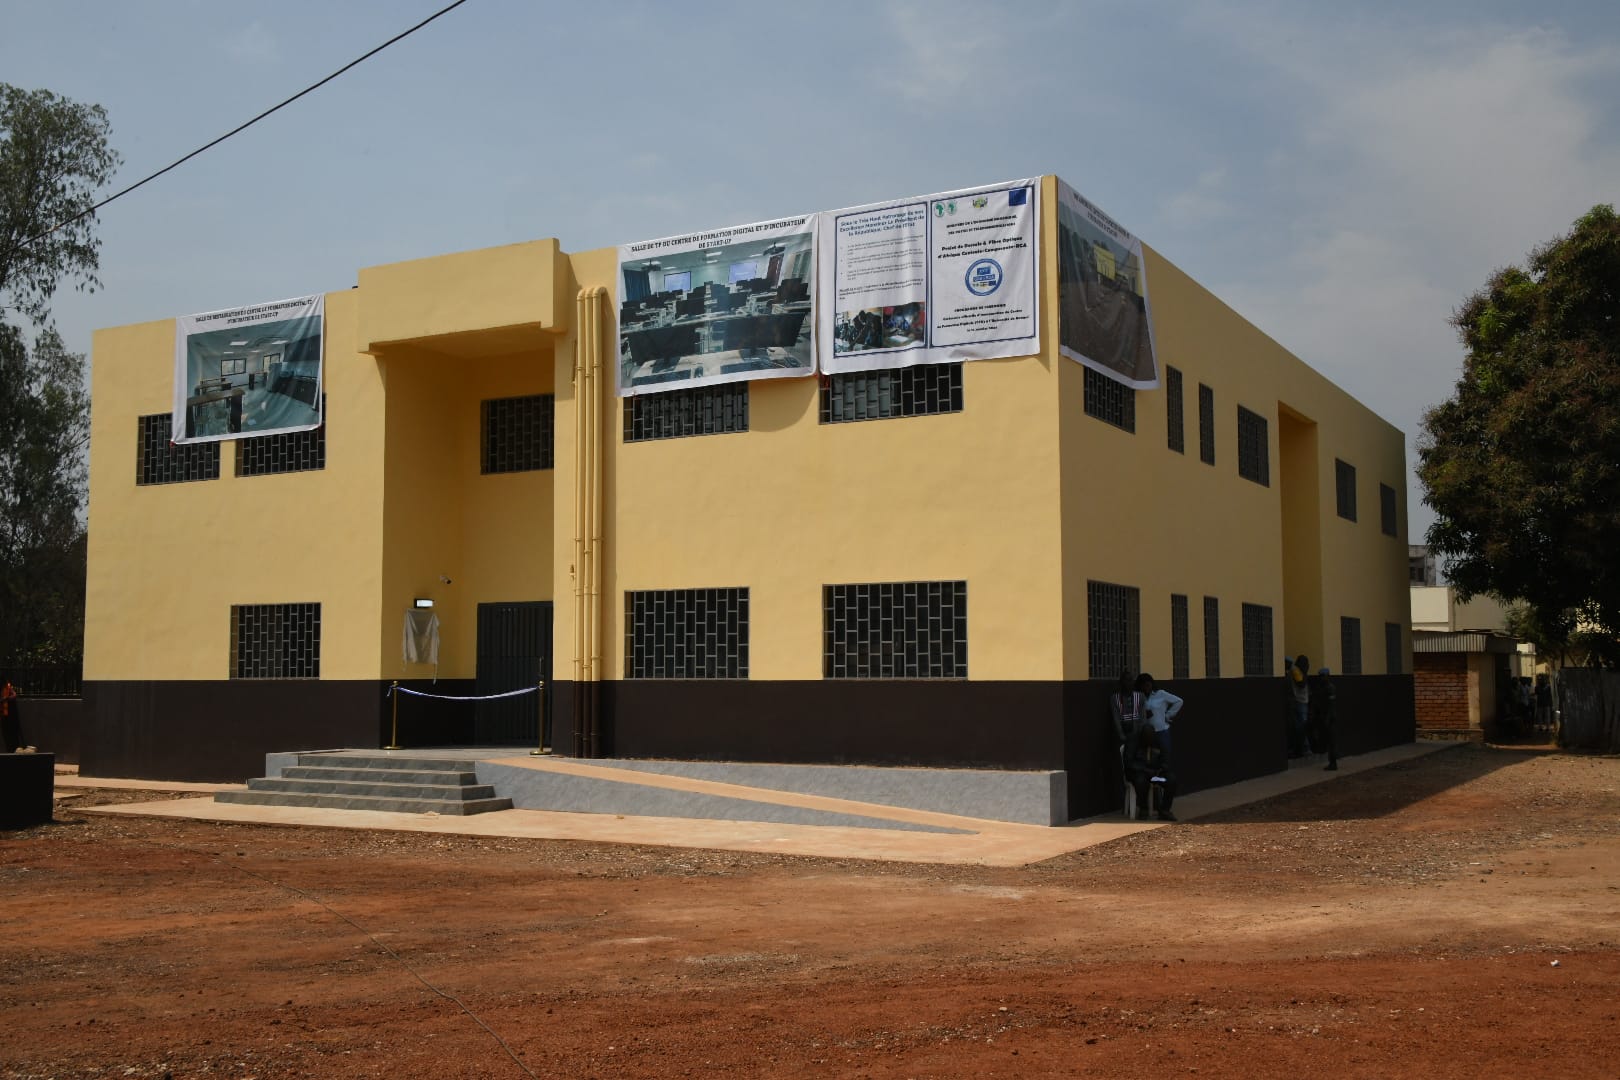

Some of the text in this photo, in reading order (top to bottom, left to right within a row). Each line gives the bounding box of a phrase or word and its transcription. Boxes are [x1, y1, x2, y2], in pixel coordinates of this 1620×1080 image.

[631, 243, 647, 253] SALLE
[671, 236, 692, 246] CENTRE
[700, 229, 732, 241] FORMATION
[733, 226, 755, 236] DIGITAL
[698, 241, 706, 249] DE
